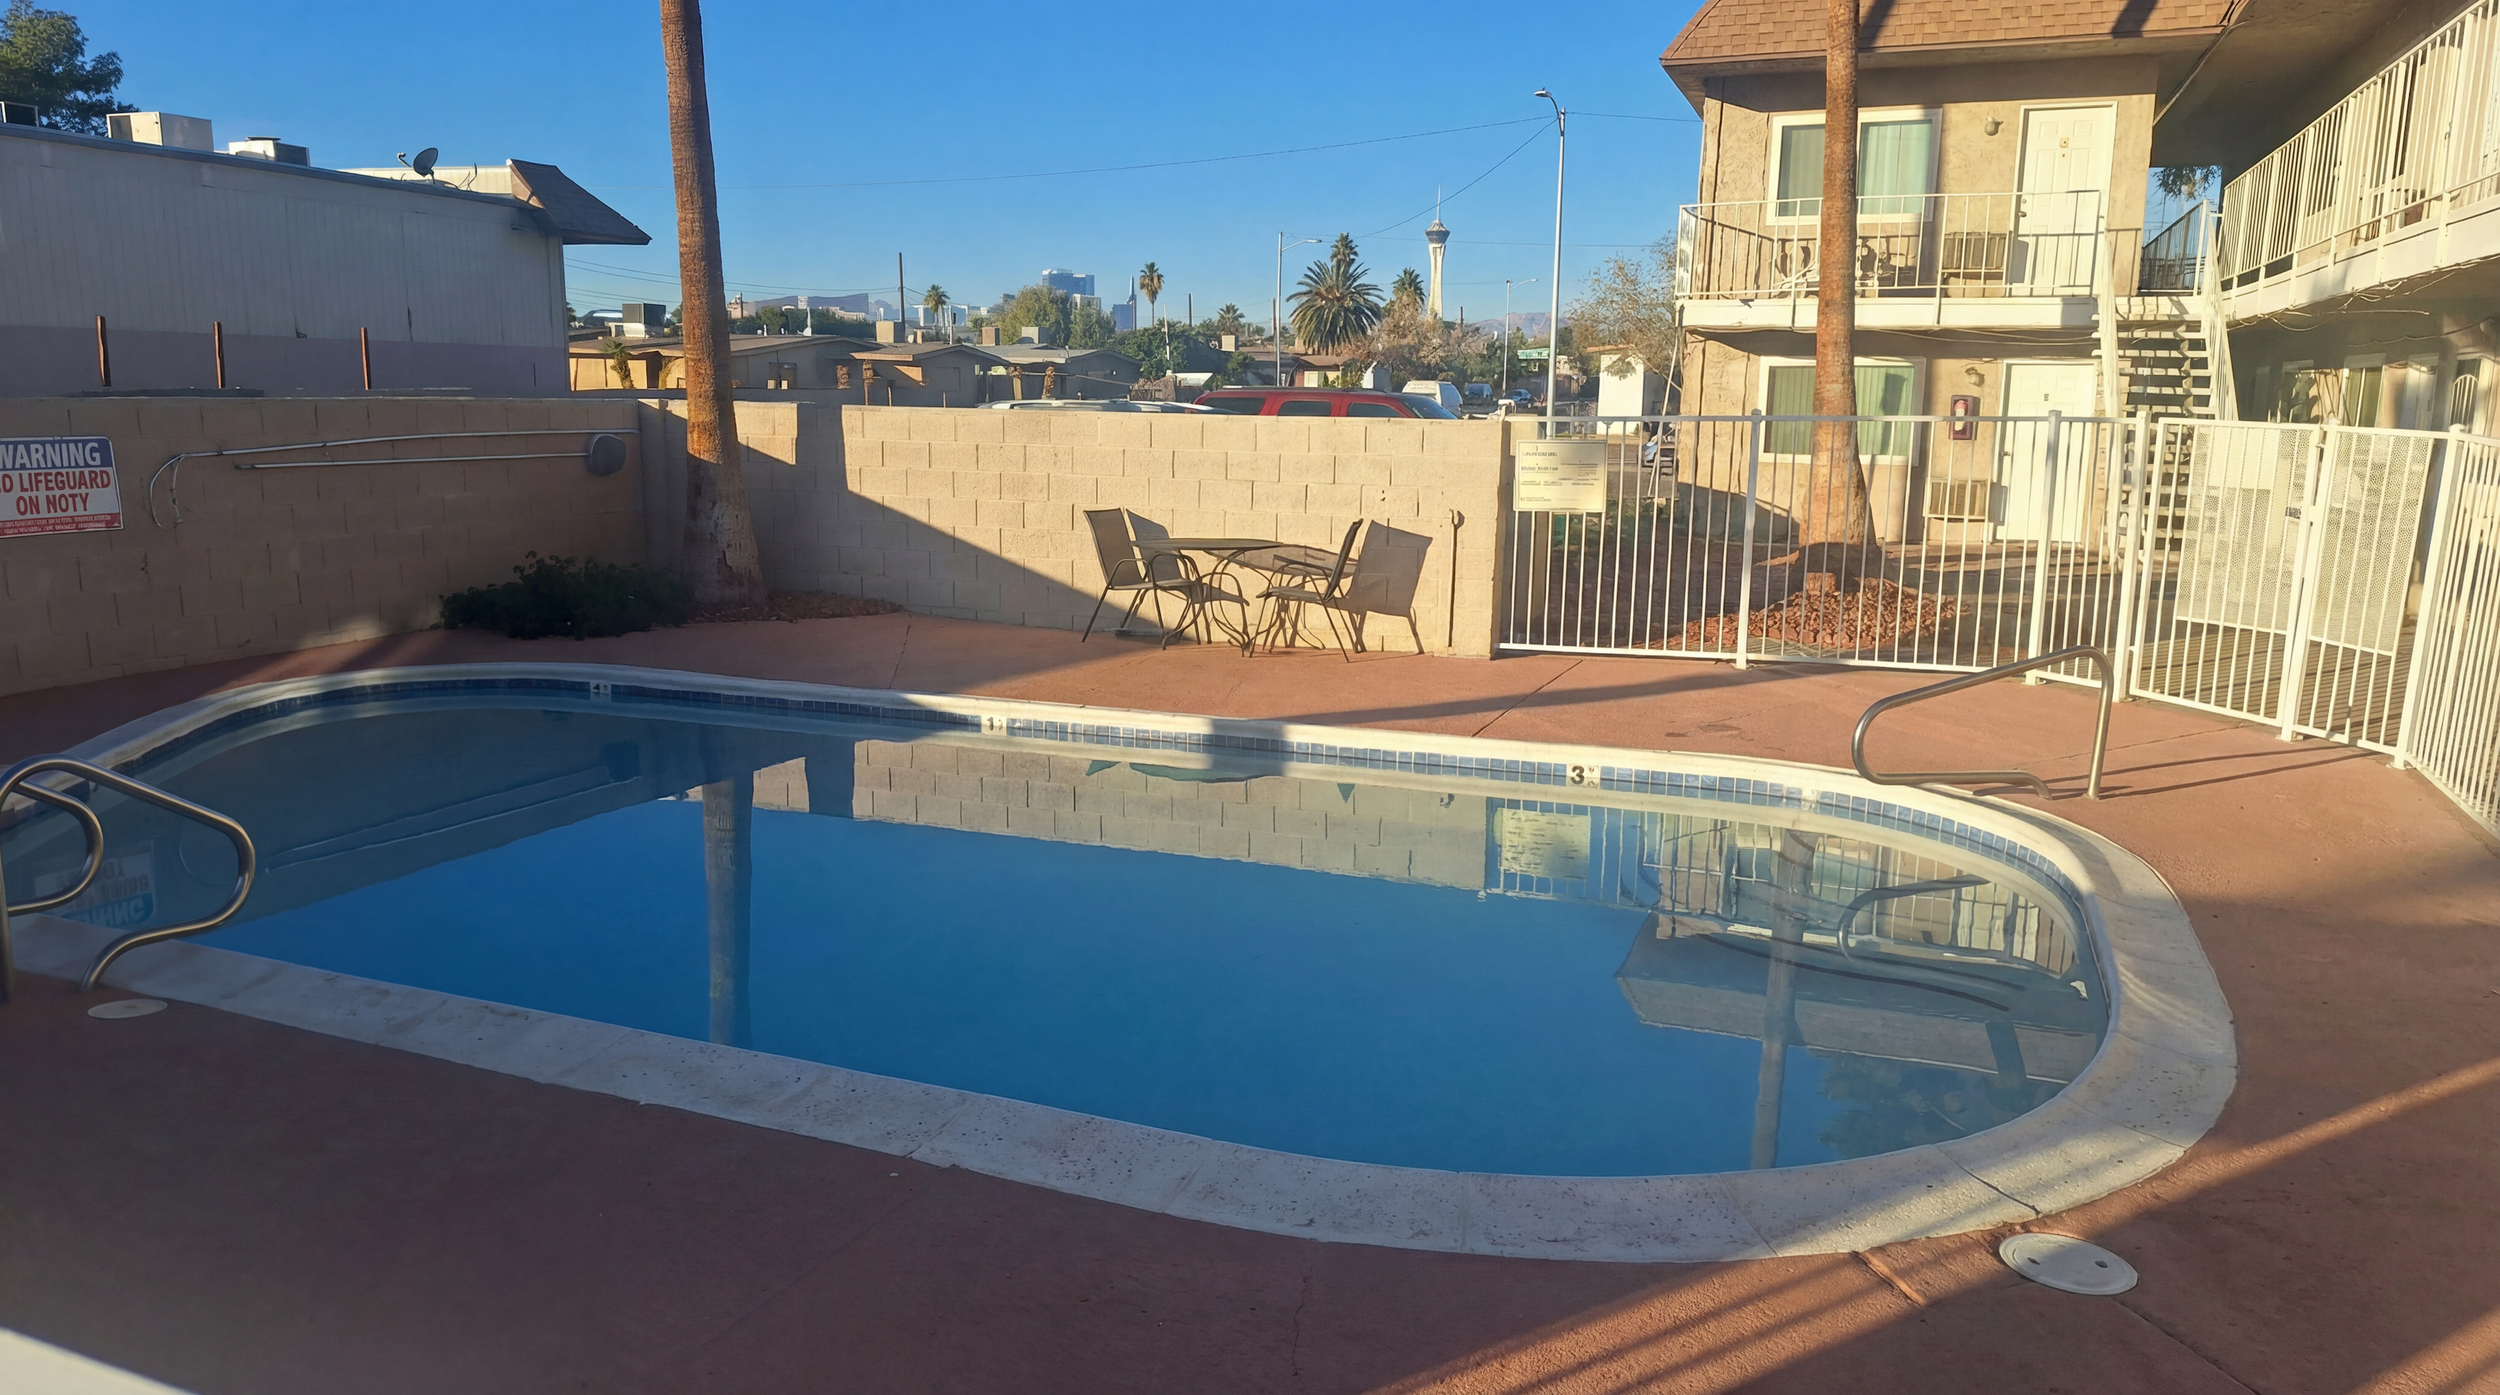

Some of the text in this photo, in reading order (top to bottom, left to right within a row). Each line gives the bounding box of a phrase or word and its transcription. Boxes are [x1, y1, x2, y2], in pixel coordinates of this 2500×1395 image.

[0, 470, 111, 493] O LIFEGUARD
[16, 495, 41, 516] ON
[1570, 765, 1585, 785] 3
